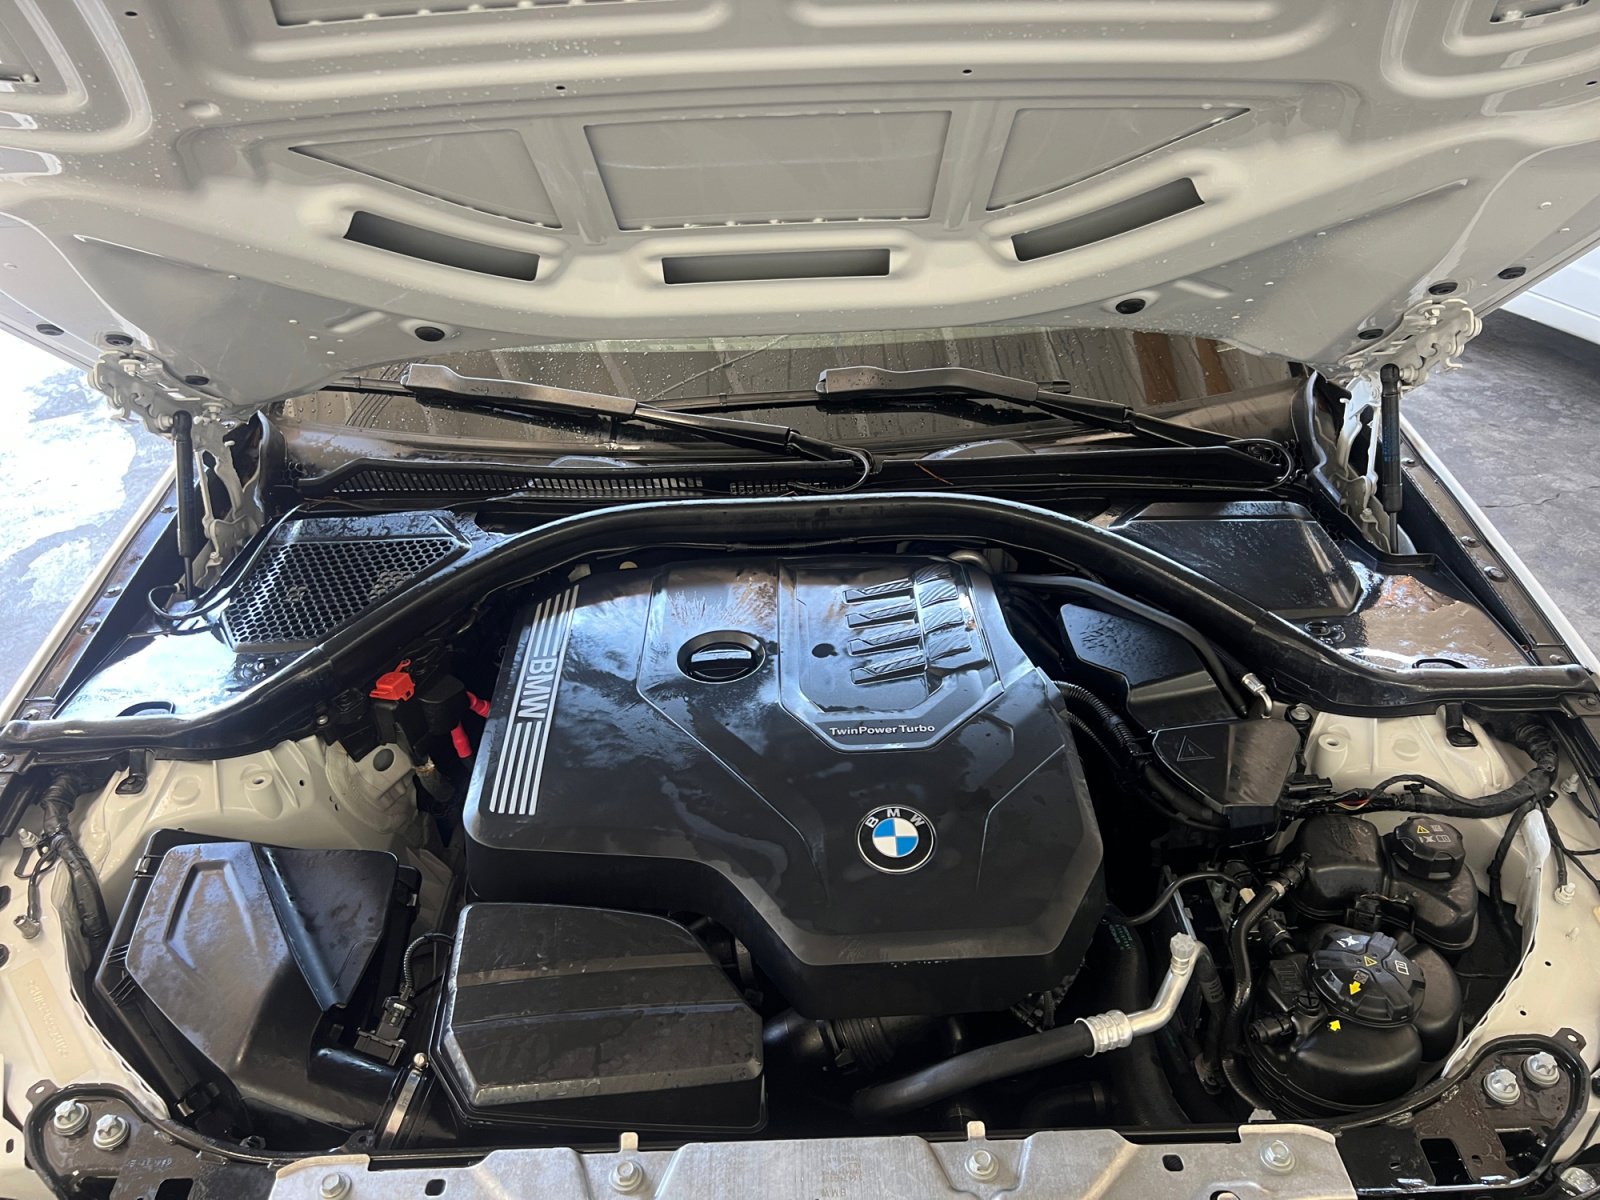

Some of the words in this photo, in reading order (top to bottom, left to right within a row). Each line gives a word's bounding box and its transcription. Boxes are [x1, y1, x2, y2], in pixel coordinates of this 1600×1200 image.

[517, 657, 558, 719] BMW
[829, 726, 898, 736] TwinPower
[898, 724, 936, 734] Turbo
[864, 808, 926, 829] BMW
